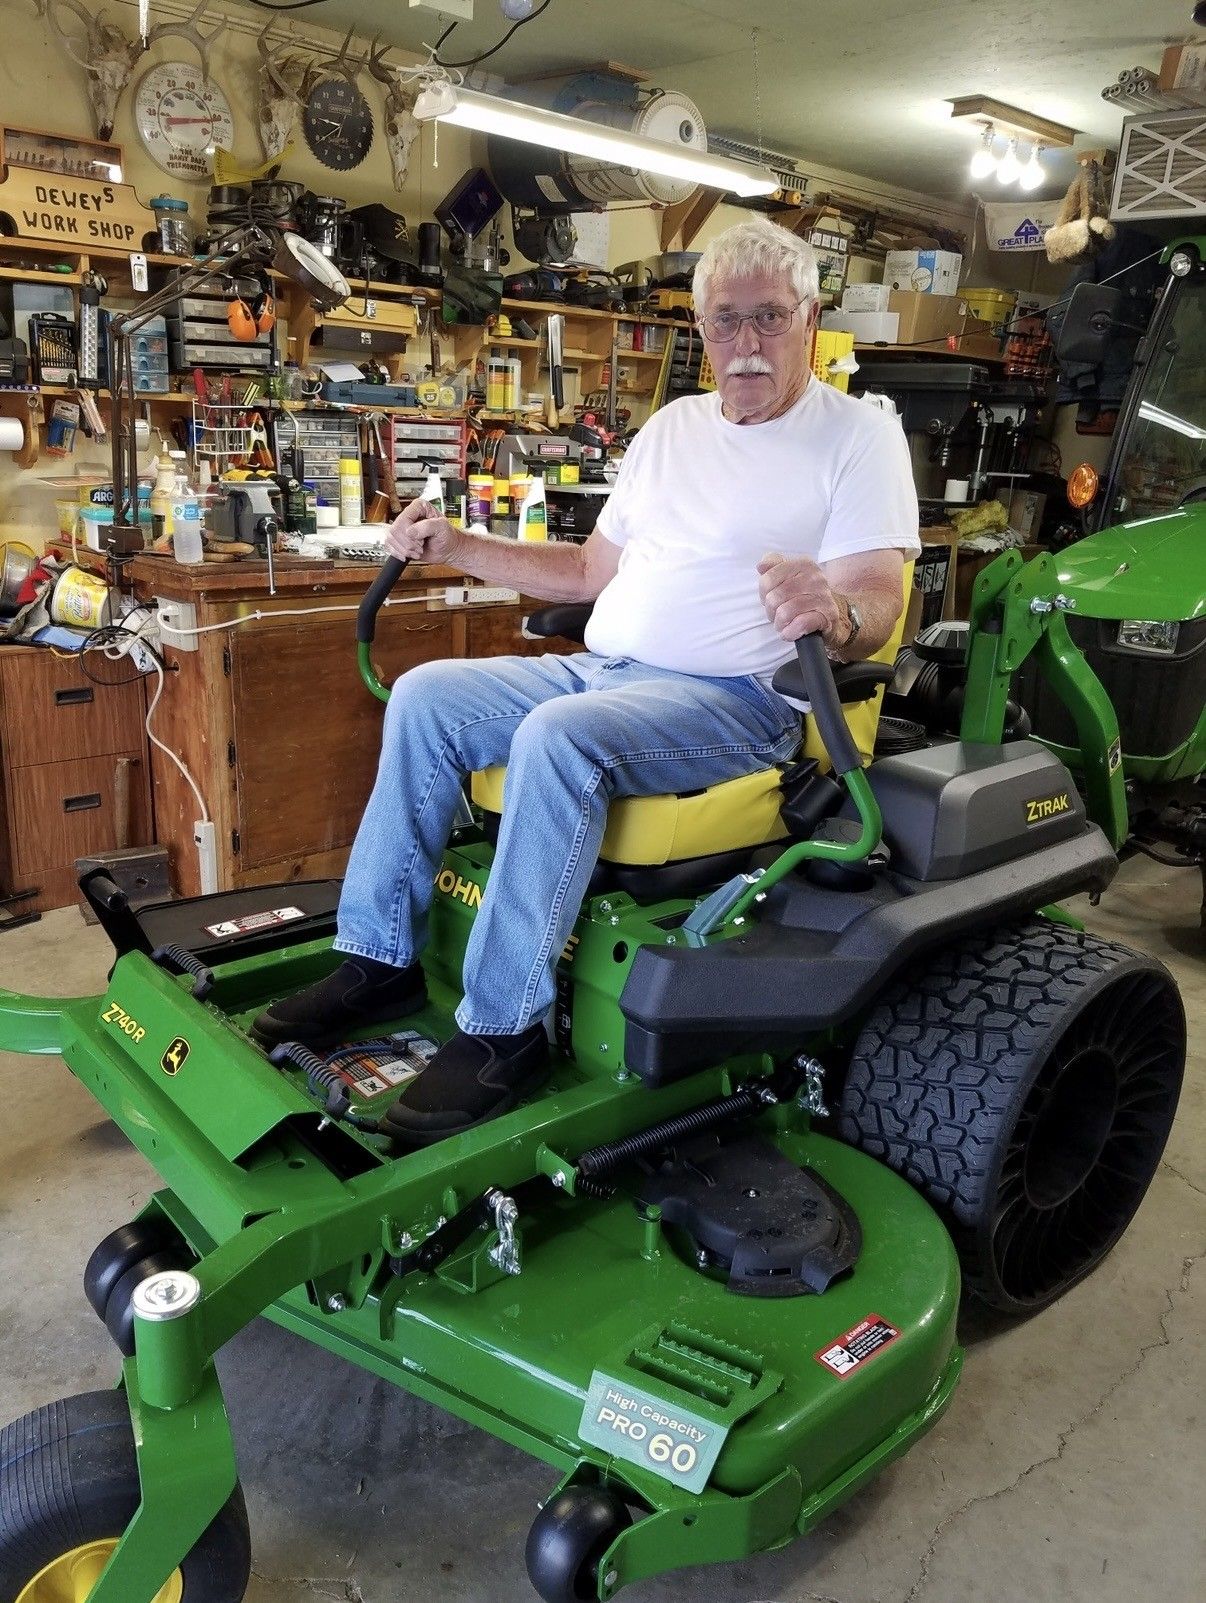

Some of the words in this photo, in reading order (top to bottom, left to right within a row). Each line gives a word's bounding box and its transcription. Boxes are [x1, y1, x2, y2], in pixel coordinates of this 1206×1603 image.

[22, 210, 78, 233] WORK
[88, 220, 135, 241] SHOP
[997, 236, 1024, 247] GREAT
[1029, 235, 1045, 245] PLA
[426, 393, 435, 401] 25
[93, 491, 113, 502] ARG
[1026, 794, 1069, 822] ZTRAK
[434, 868, 484, 911] OHN
[849, 1321, 871, 1338] DANGER
[605, 1389, 638, 1412] High
[640, 1404, 707, 1443] Capacity
[596, 1406, 647, 1440] PRO
[648, 1433, 697, 1473] 60
